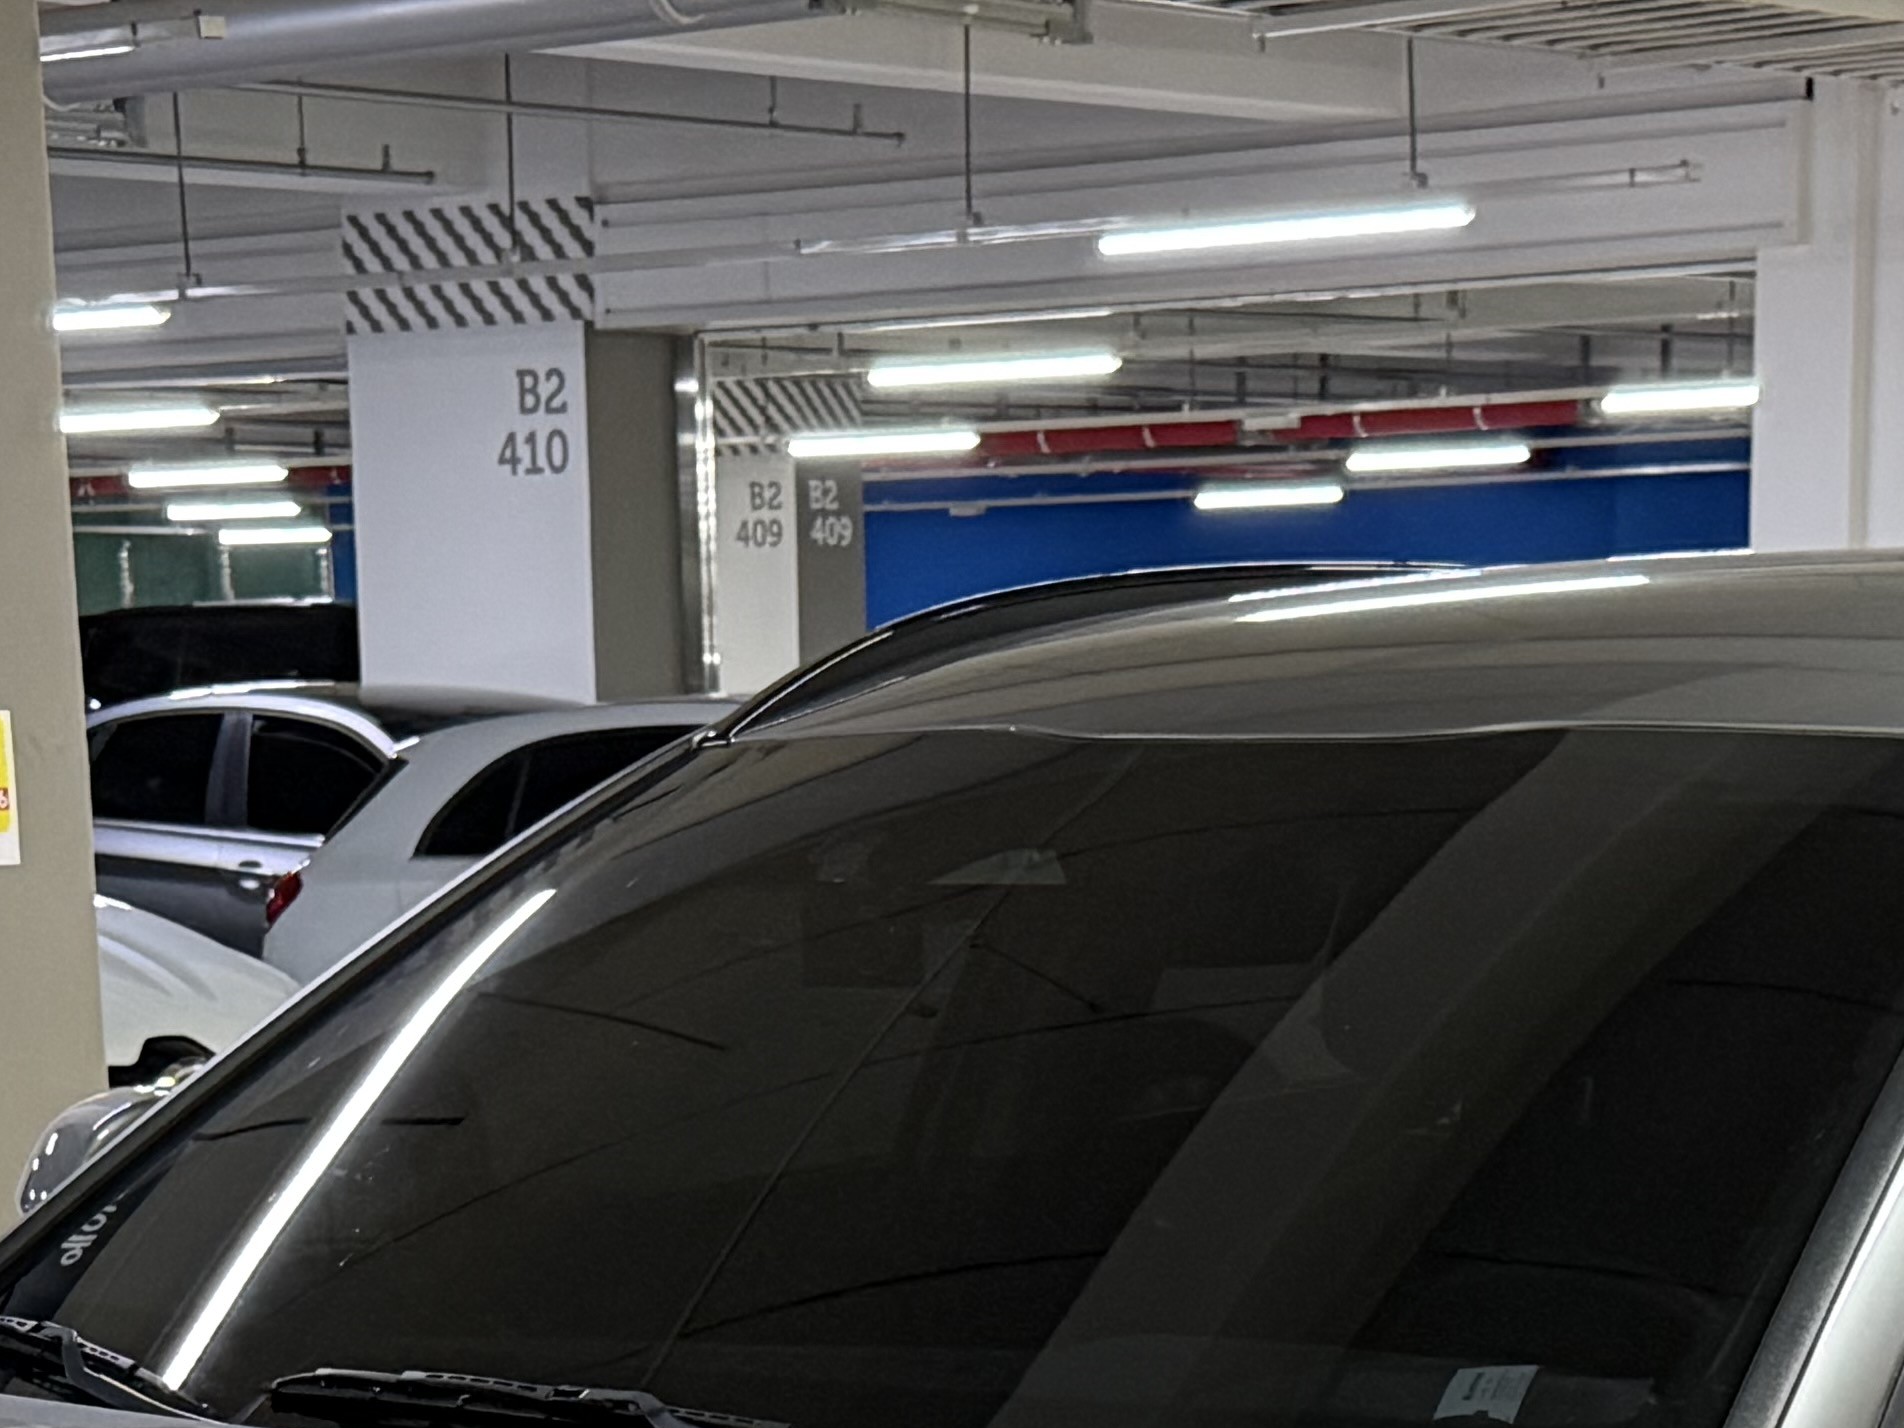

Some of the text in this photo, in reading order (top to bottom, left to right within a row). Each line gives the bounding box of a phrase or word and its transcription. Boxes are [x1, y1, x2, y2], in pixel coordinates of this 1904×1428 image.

[516, 368, 569, 416] B2
[497, 428, 570, 476] 410
[749, 480, 783, 512] B2
[807, 480, 839, 511] B2
[736, 519, 783, 548] 409
[811, 516, 853, 548] 409
